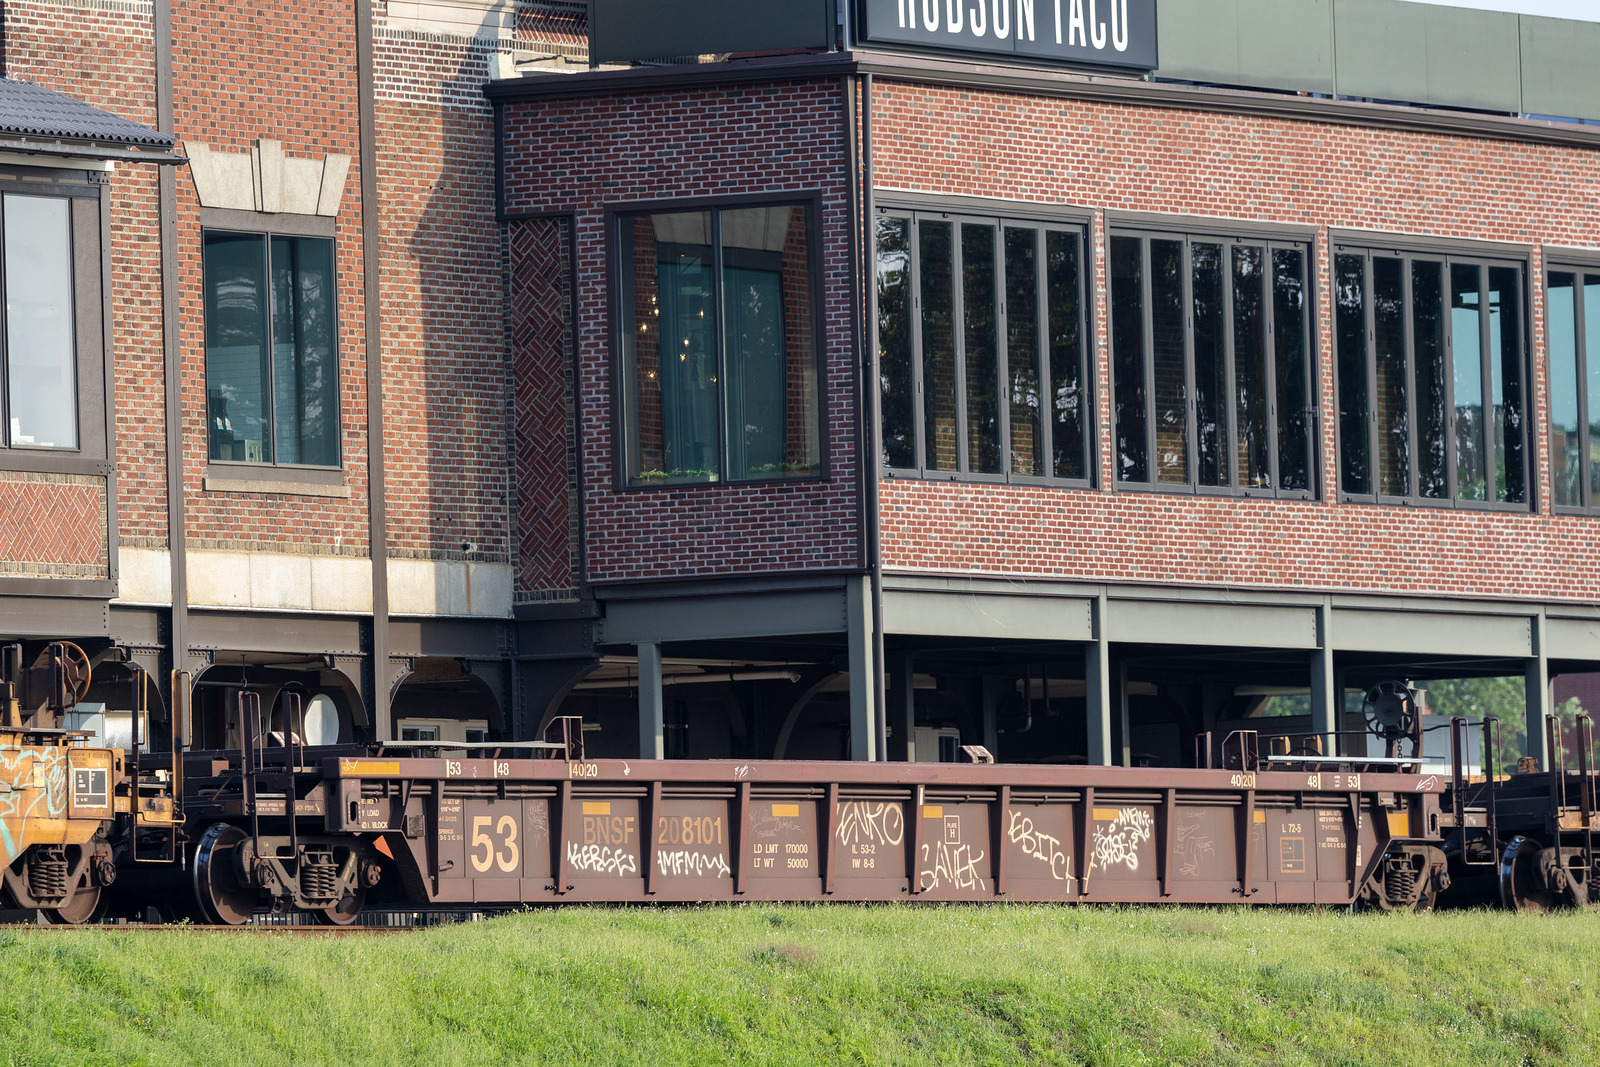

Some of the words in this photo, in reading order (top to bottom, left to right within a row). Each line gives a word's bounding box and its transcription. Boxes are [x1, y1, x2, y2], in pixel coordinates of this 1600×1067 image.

[1054, 0, 1129, 52] TACO
[450, 762, 461, 776] 53
[498, 763, 509, 776] 48
[573, 764, 583, 777] 40
[587, 764, 598, 777] 20
[1230, 774, 1241, 787] 40
[1242, 775, 1253, 787] 20
[1307, 775, 1318, 788] 48
[1347, 776, 1358, 788] 53
[583, 816, 635, 844] BNSF
[658, 816, 722, 845] 208101
[949, 828, 956, 839] H
[1281, 823, 1287, 833] L
[1288, 823, 1302, 833] 72-5
[470, 815, 519, 873] 53
[753, 844, 763, 854] LD
[765, 844, 779, 854] LMT
[785, 844, 808, 854] 170000
[860, 844, 876, 854] 53-2
[753, 858, 761, 868] LT
[763, 858, 775, 868] WT
[787, 858, 809, 869] 50000
[852, 858, 861, 868] IW
[863, 858, 875, 868] 8-8
